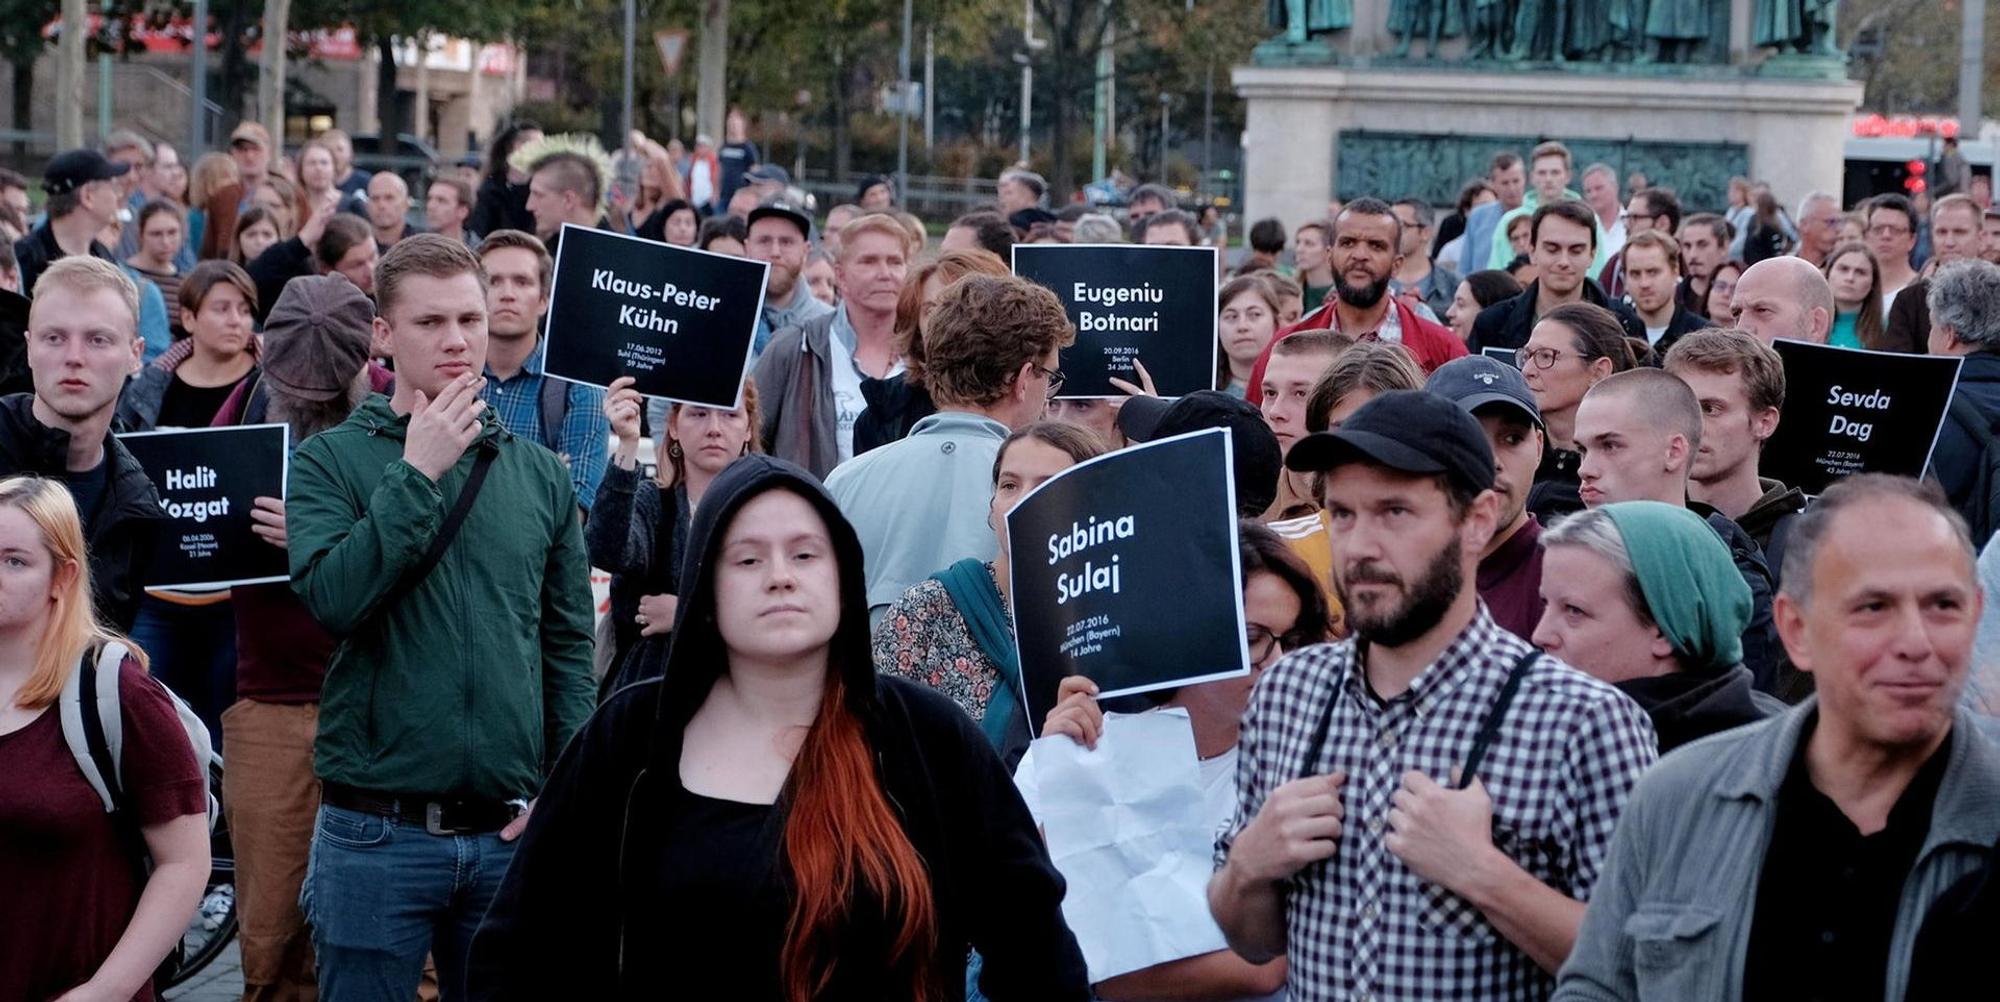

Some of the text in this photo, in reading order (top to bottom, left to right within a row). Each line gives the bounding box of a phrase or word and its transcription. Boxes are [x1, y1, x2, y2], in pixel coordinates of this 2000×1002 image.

[592, 268, 720, 311] Klaus-Peter
[1074, 282, 1163, 307] Eugeniu
[618, 304, 679, 335] Kühn
[1080, 311, 1158, 331] Botnari
[617, 349, 632, 358] Suhl
[626, 342, 662, 356] 17.06.2012
[1103, 347, 1139, 355] 20.09.2016
[626, 360, 654, 371] 59 Jahre
[1827, 385, 1891, 409] Sevda
[1829, 415, 1873, 442] Dag
[166, 466, 217, 490] Halit
[1048, 515, 1135, 565] Sabina
[1057, 554, 1120, 605] Sulaj
[1067, 614, 1109, 637] 22.07.2016
[1086, 625, 1121, 643] (Bayern)
[1070, 643, 1102, 659] 14 Jahre
